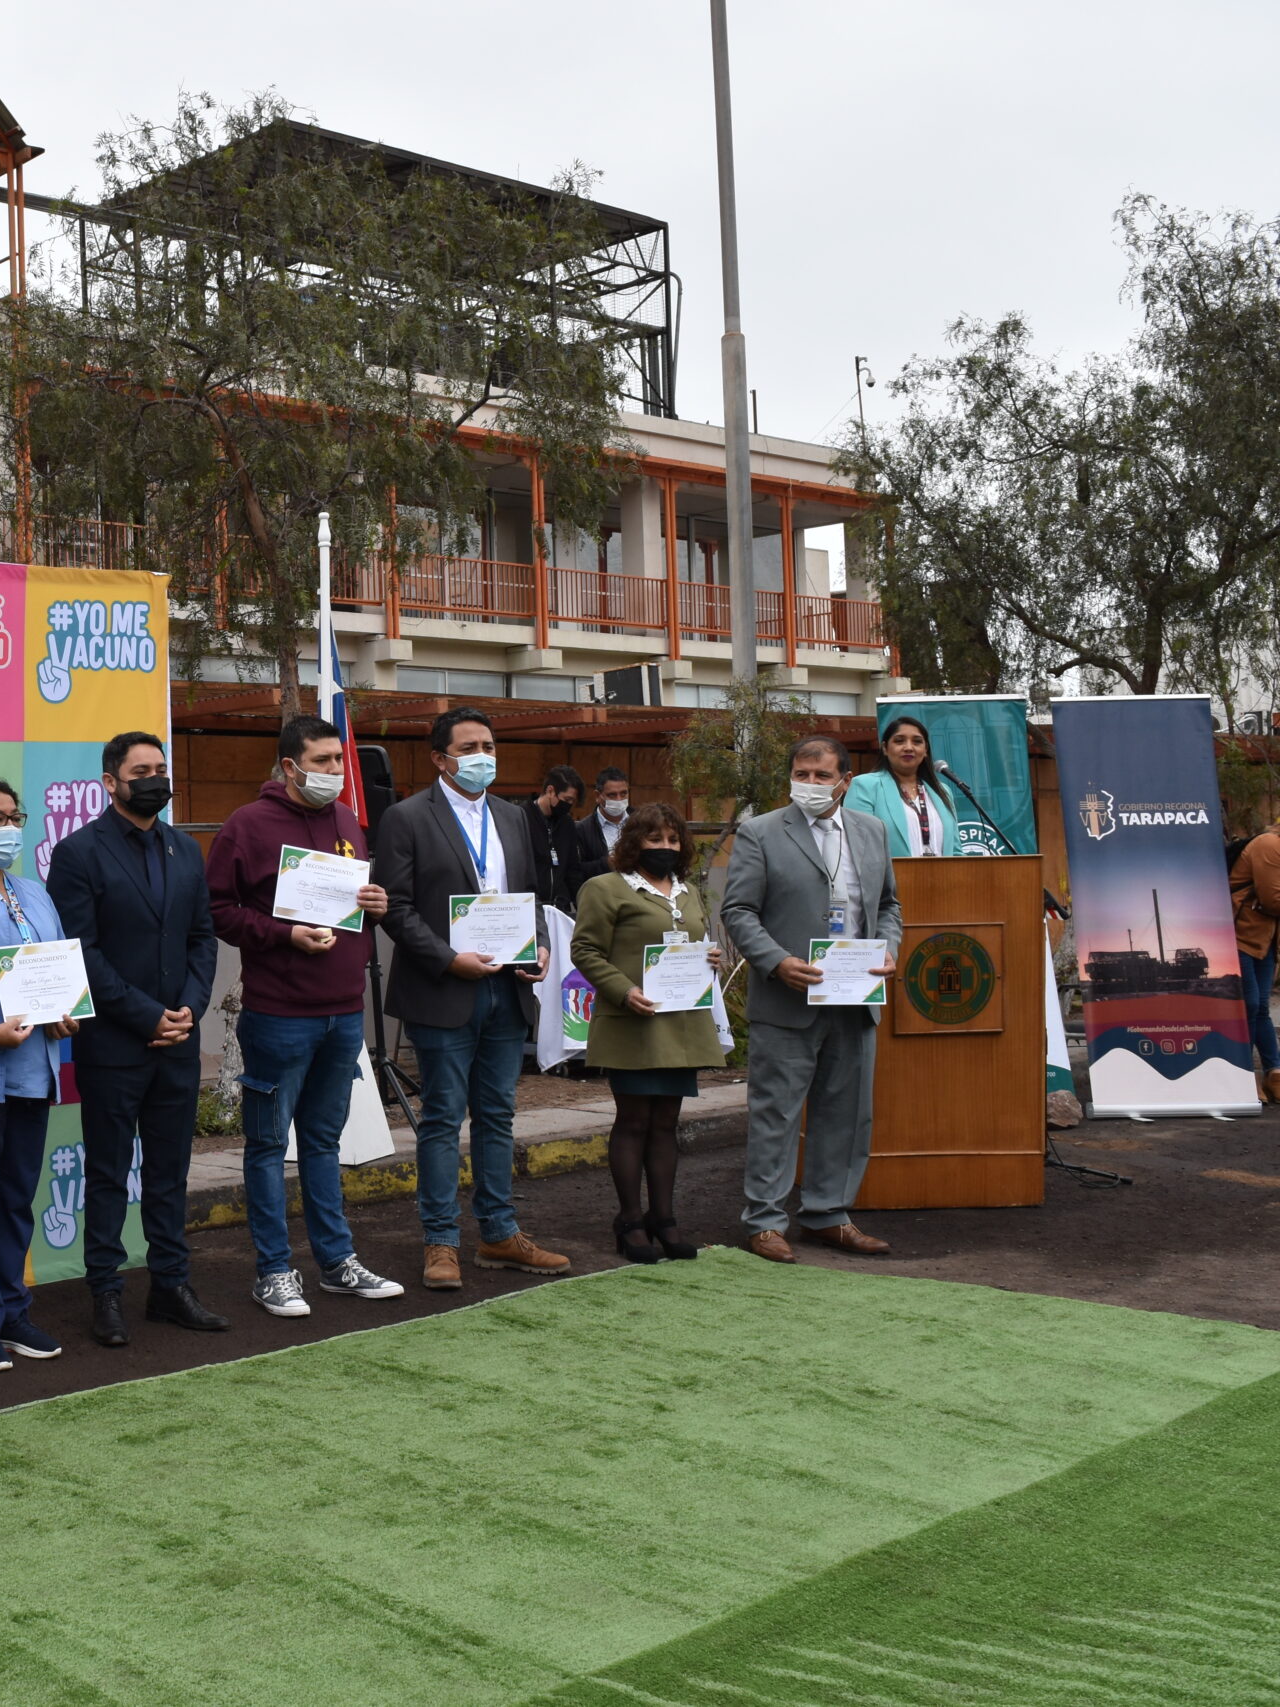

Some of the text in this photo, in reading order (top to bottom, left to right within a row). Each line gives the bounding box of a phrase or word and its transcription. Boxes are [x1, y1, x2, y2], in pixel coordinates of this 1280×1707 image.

[50, 602, 149, 637] #YO ME
[48, 634, 155, 671] VACUNO
[47, 782, 102, 815] #YO
[1118, 802, 1208, 811] GOBIERNO REGIONAL
[1119, 810, 1210, 826] TARAPACÁ
[305, 862, 354, 877] RECONOCIMIENTO
[474, 906, 521, 914] RECONOCIMIENTO
[19, 955, 68, 964] RECONOCIMIENTO
